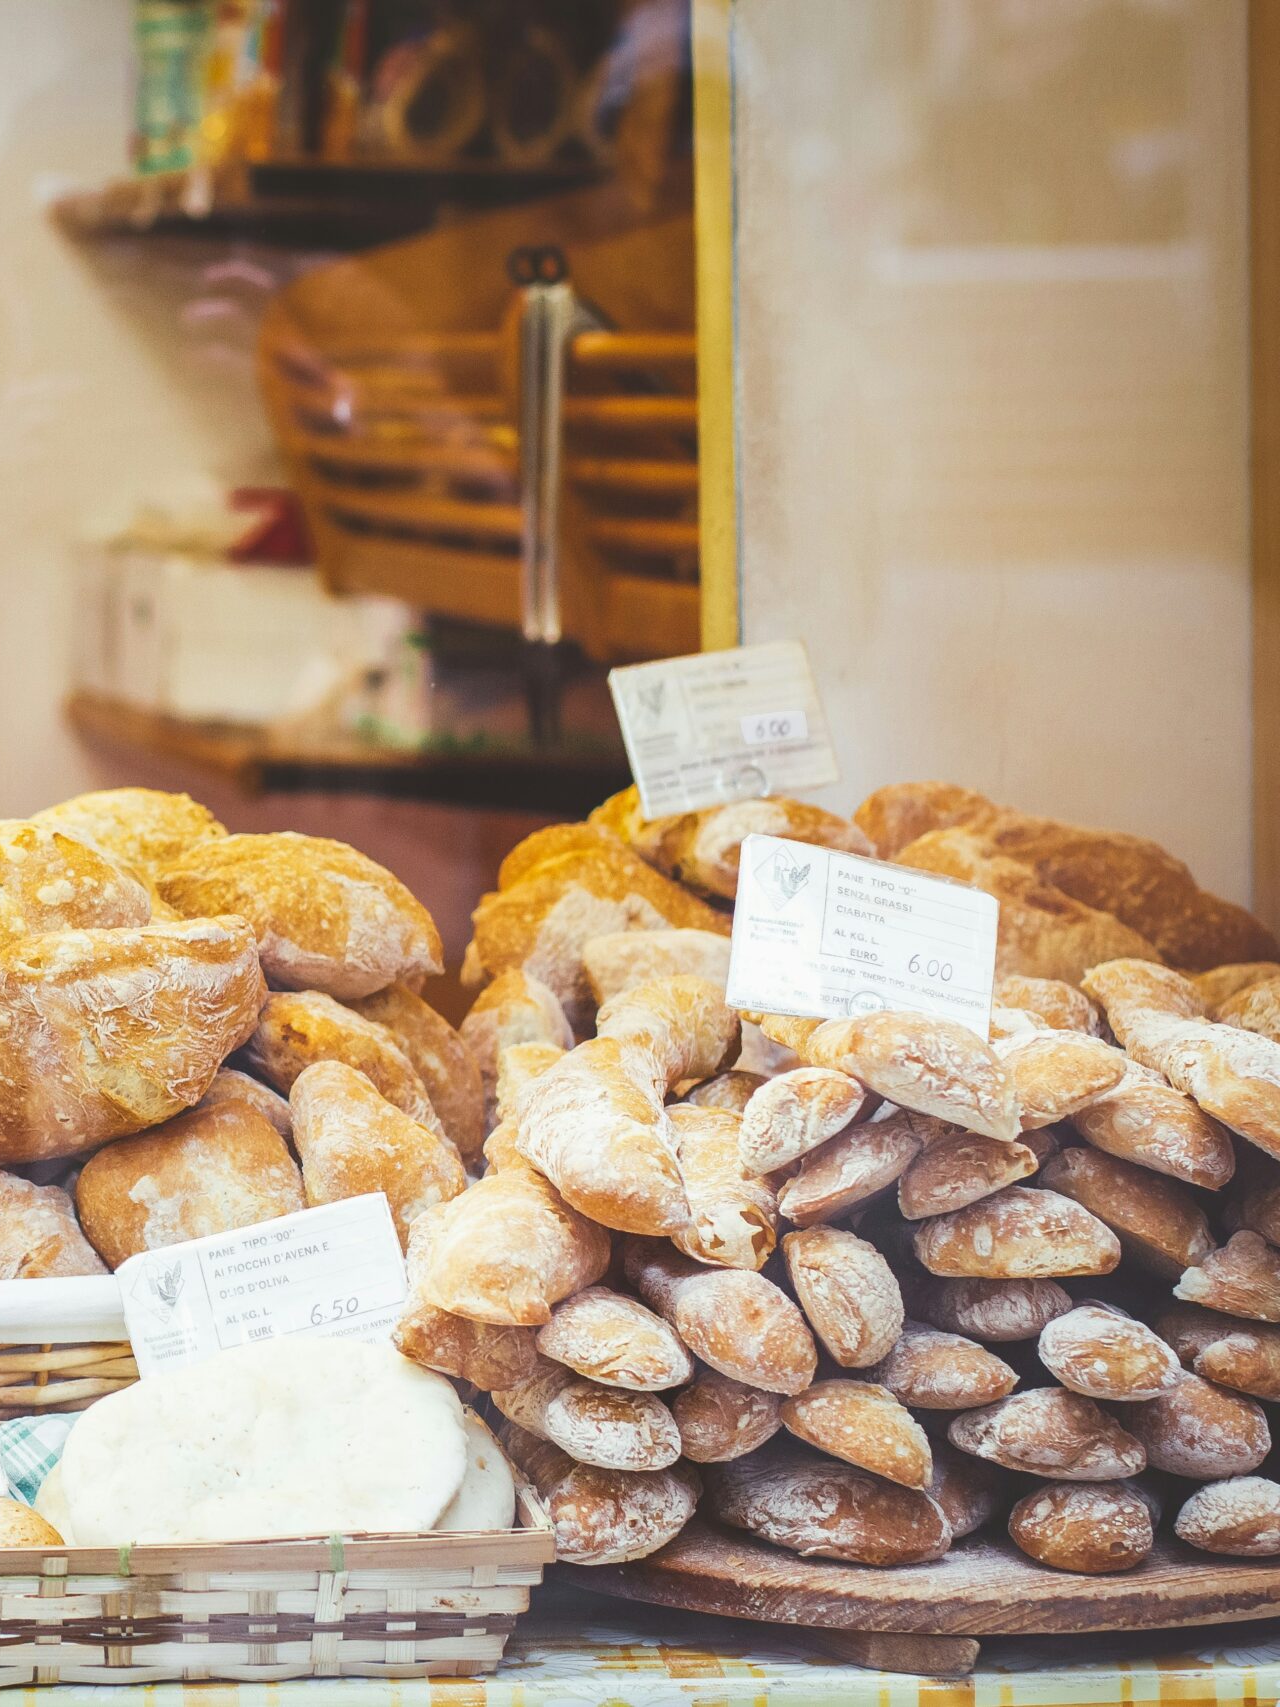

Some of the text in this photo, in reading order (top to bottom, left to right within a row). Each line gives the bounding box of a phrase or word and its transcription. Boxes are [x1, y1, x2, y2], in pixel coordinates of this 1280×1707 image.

[837, 869, 864, 884] PANE
[871, 878, 895, 892] TIPO
[837, 886, 913, 913] SENZA GRASSI
[836, 904, 886, 925] CIABATTA
[832, 927, 847, 938] AL
[850, 948, 879, 962] EURO
[907, 953, 953, 982] 6.00
[208, 1246, 236, 1261] PANE
[241, 1235, 268, 1249] TIPO
[214, 1240, 331, 1280] AI FIOCCHI D'AVENA E
[218, 1274, 291, 1300] OLIO D'OLIVA
[309, 1296, 359, 1326] 6.50
